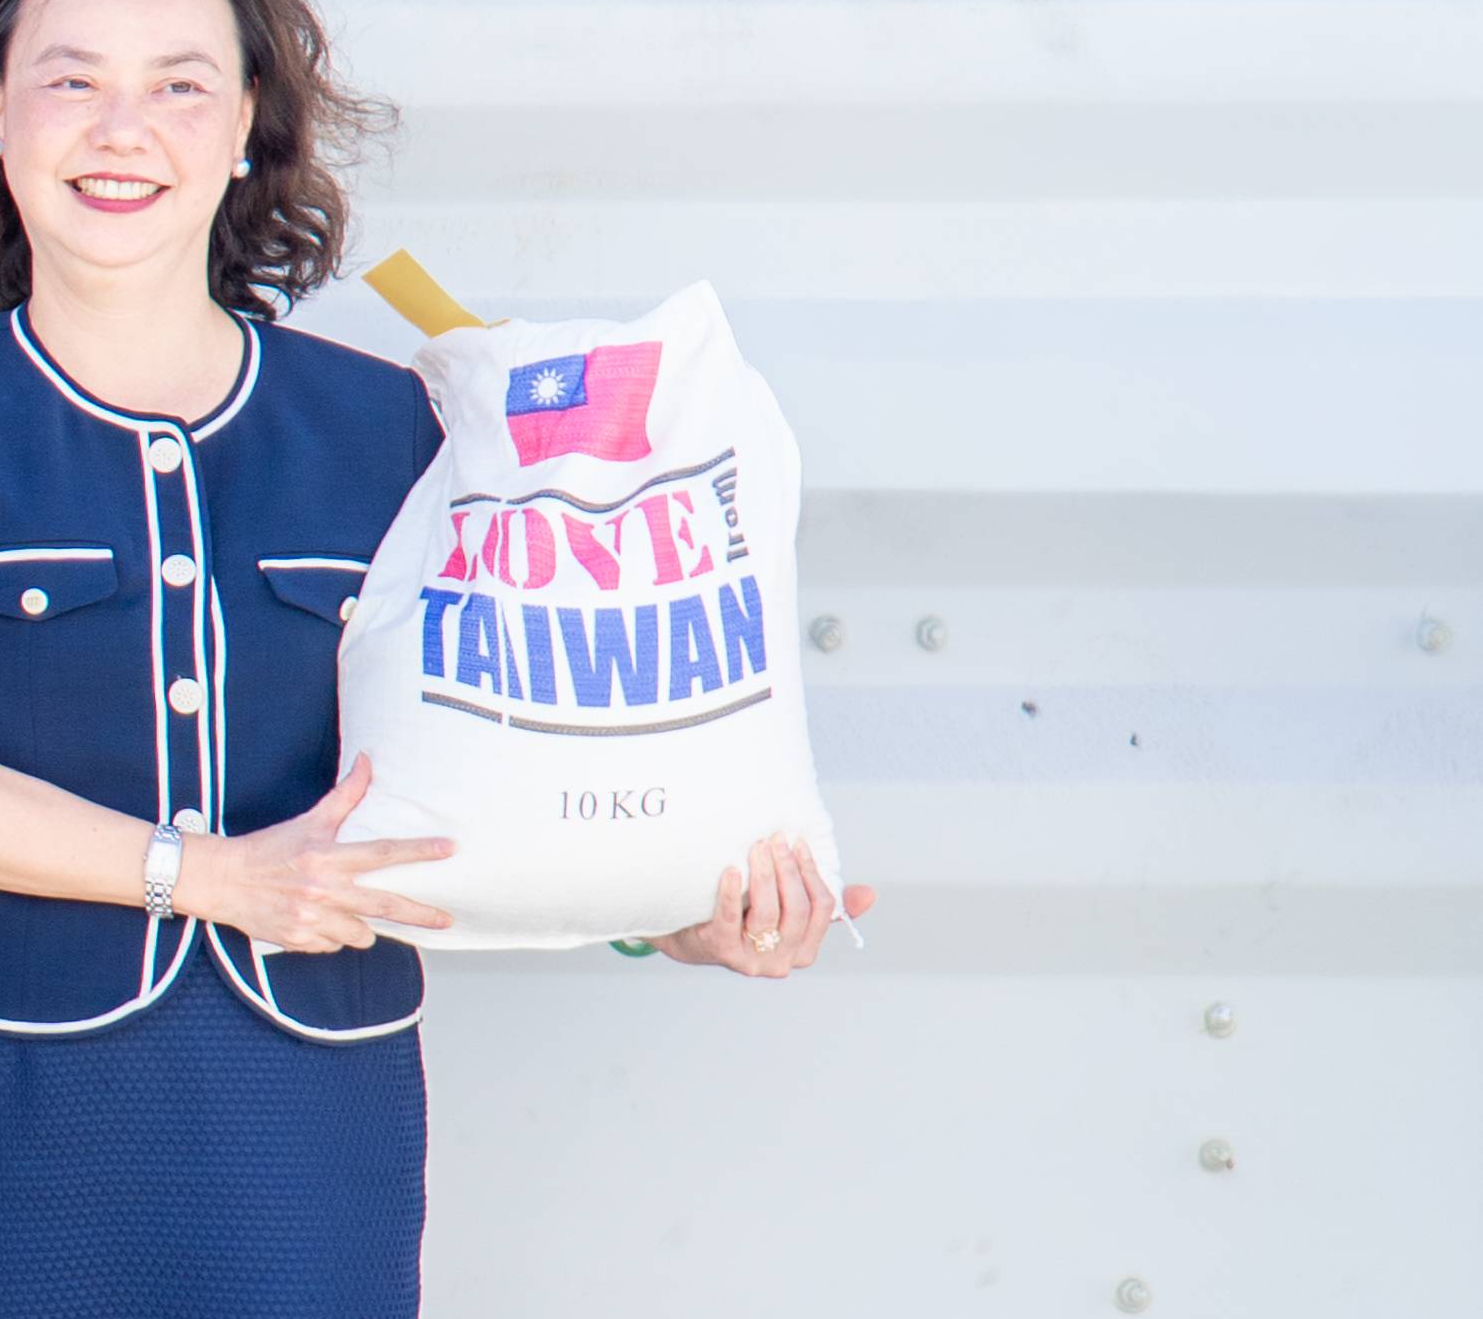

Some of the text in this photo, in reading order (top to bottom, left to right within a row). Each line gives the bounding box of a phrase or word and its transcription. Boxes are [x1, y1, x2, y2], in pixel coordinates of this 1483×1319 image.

[437, 489, 714, 590] LOVE
[419, 574, 766, 707] TAIWAN
[558, 787, 667, 820] 10 KG
